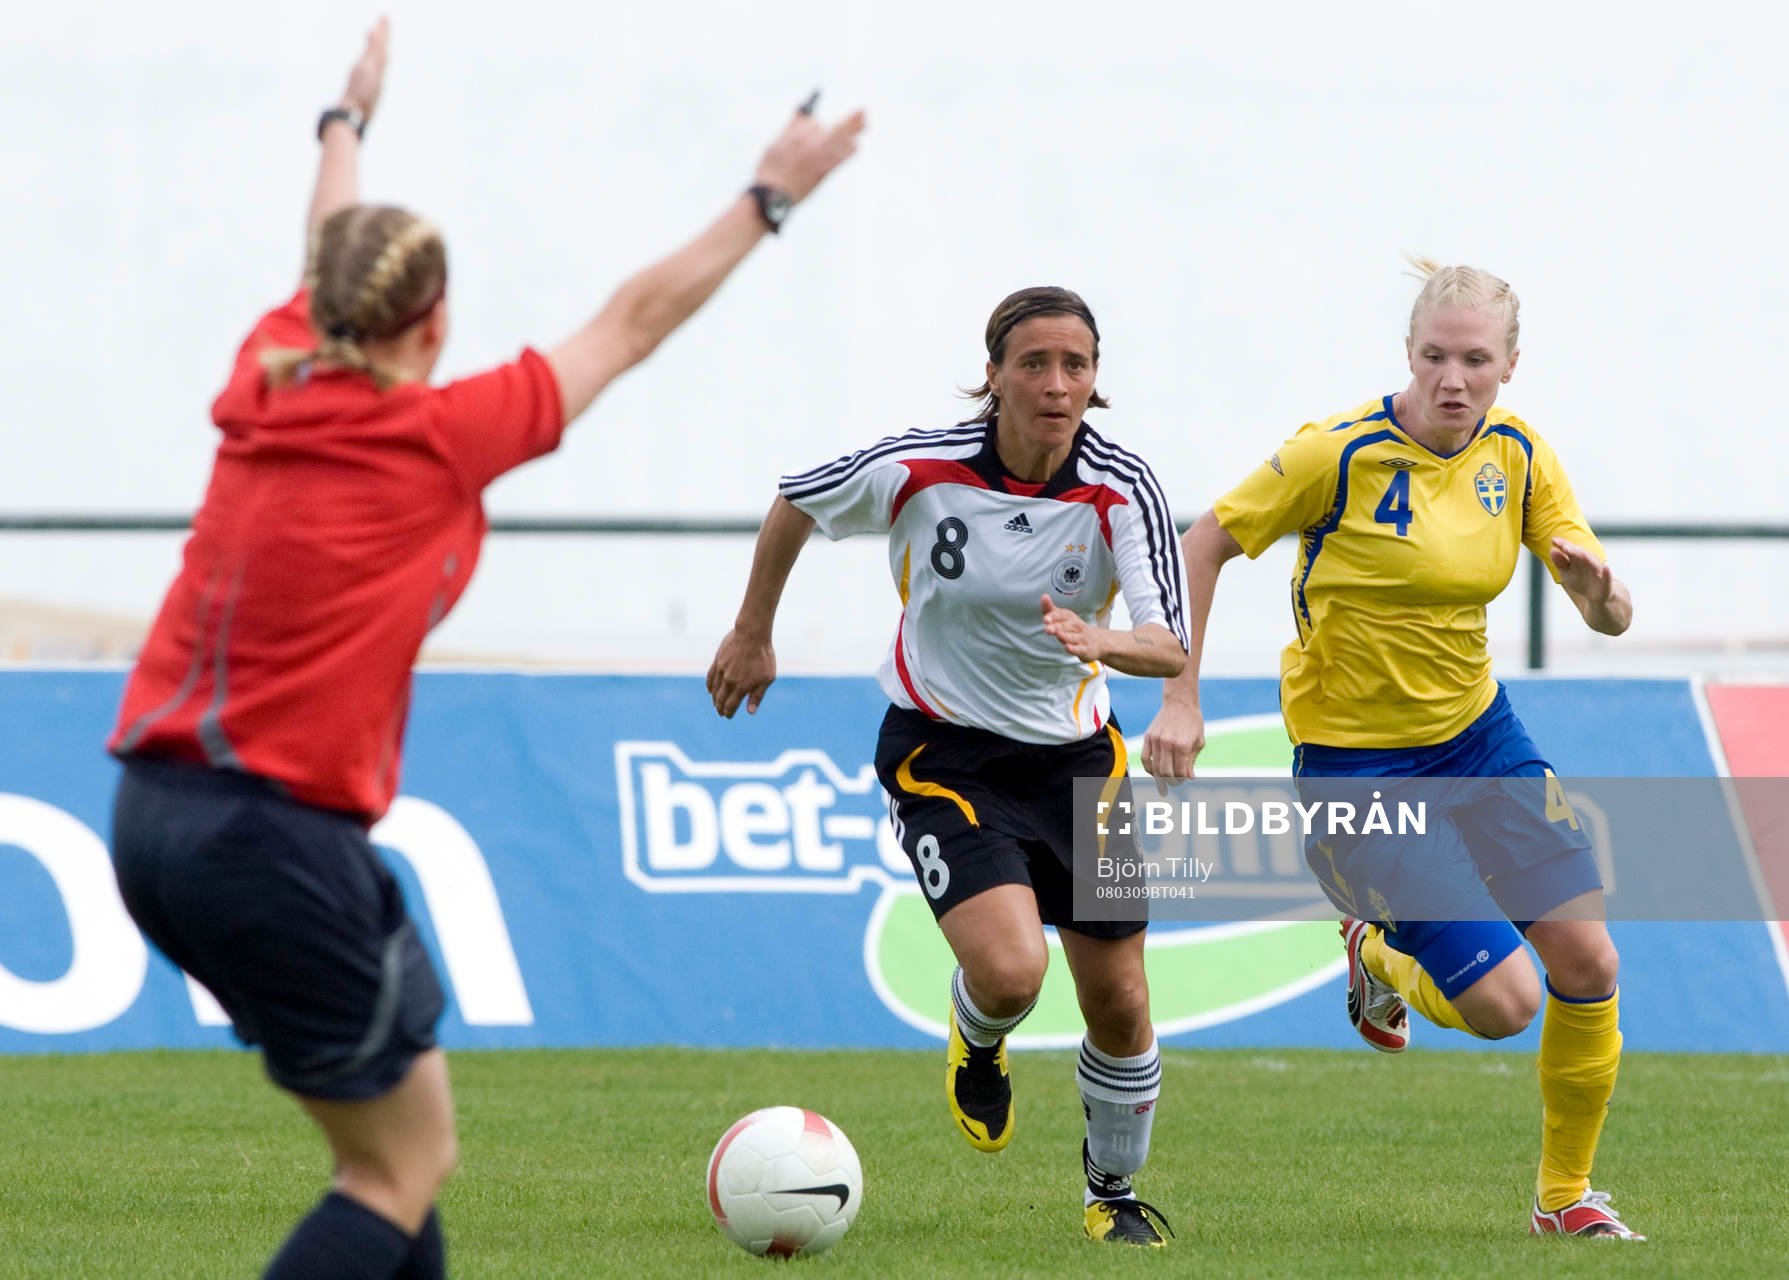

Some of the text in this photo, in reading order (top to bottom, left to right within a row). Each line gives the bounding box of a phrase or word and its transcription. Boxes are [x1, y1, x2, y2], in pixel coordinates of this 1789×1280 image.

[1374, 469, 1414, 537] 4
[931, 516, 969, 580] 8
[1545, 768, 1579, 832] 4
[916, 834, 950, 900] 8
